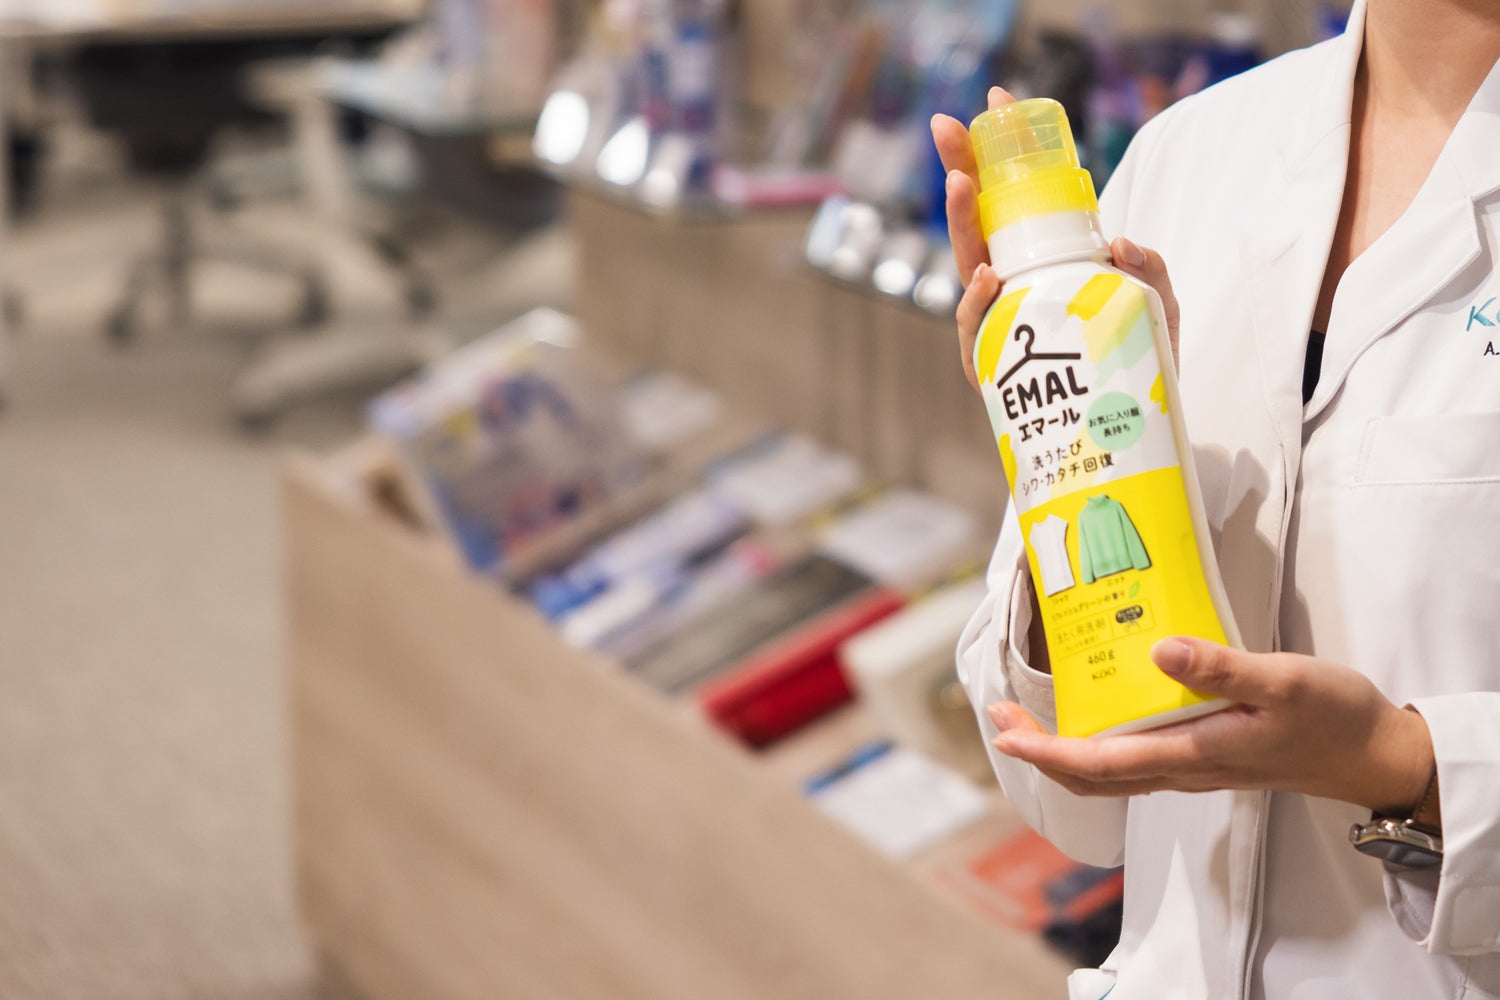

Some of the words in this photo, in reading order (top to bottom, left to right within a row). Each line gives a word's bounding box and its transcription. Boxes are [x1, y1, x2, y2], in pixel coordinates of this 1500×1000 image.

[1002, 365, 1089, 421] EMAL
[1018, 407, 1081, 443] エマール
[1088, 406, 1141, 428] お気に入り服
[1103, 424, 1131, 438] 長持ち
[1031, 438, 1083, 471] 洗うたび
